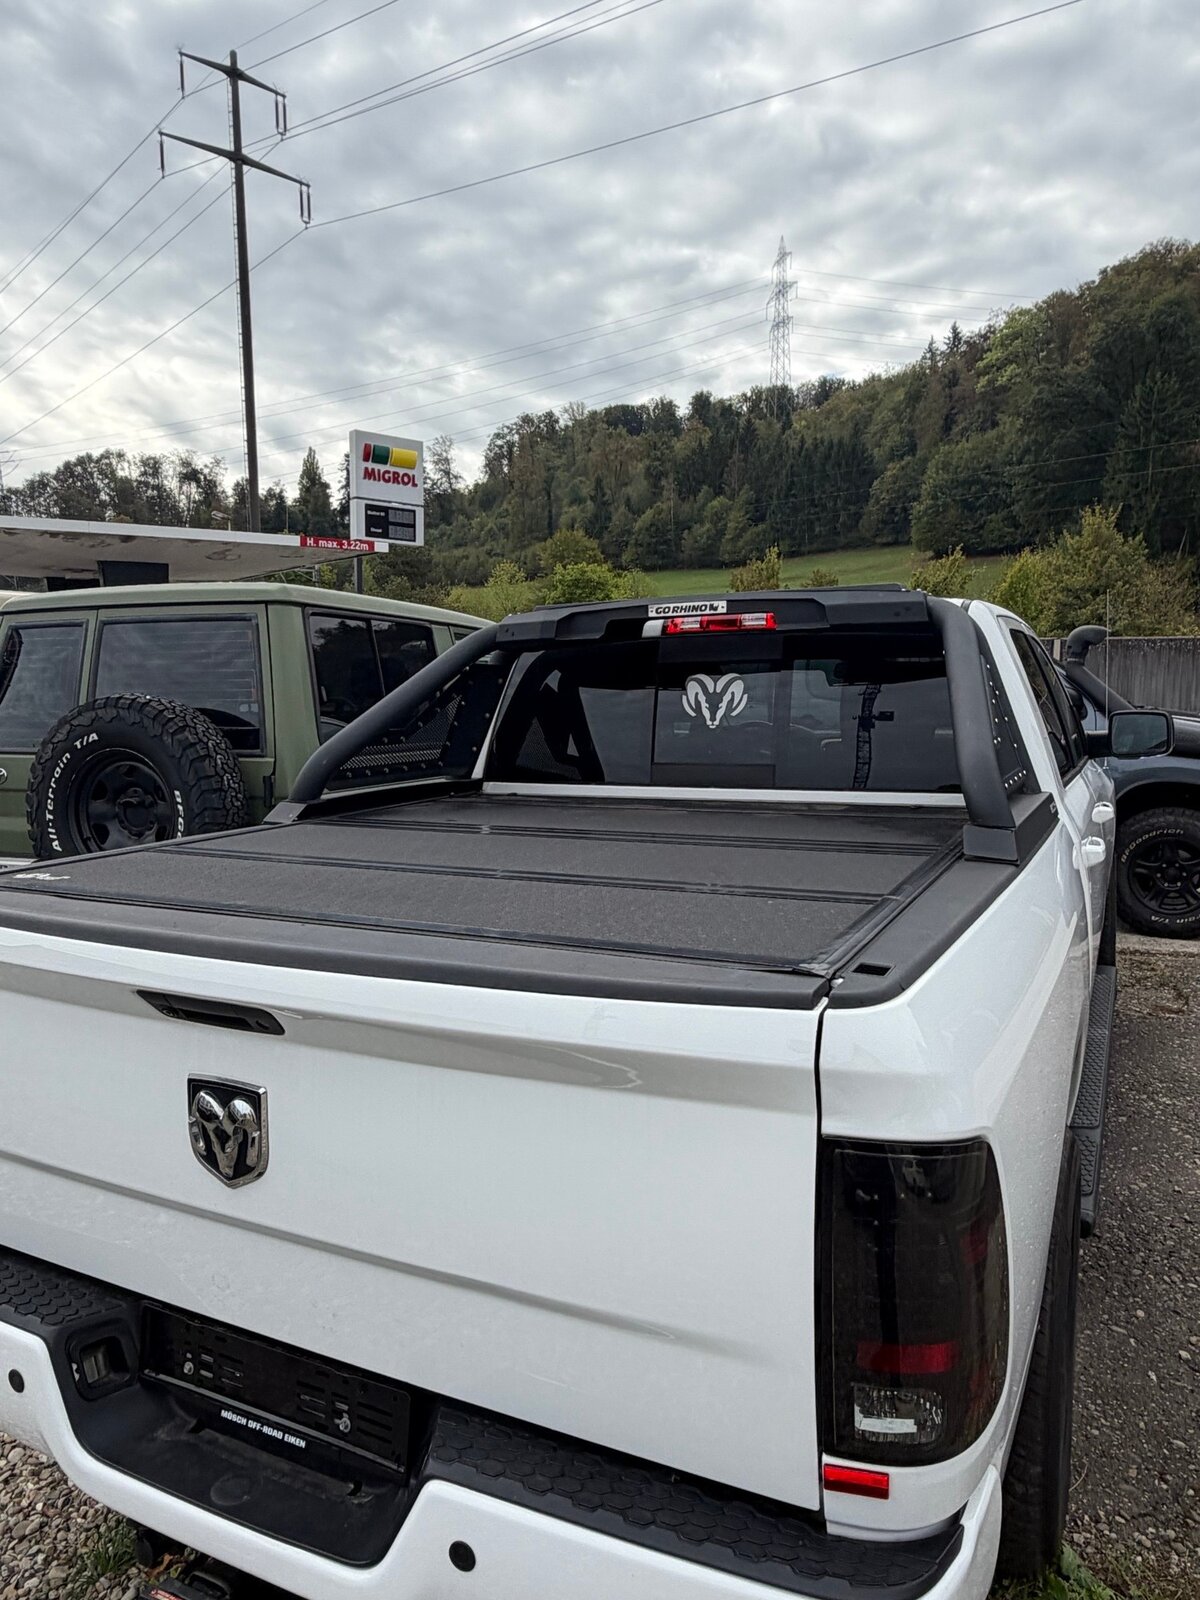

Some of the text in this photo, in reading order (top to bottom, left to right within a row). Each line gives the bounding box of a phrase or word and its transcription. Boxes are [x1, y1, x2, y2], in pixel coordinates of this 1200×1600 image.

[363, 467, 418, 487] MIGROL
[306, 537, 369, 551] H. max. 3.22m
[74, 732, 98, 750] T/A
[248, 1420, 283, 1440] OFF-ROAD
[284, 1433, 306, 1449] EIKEN
